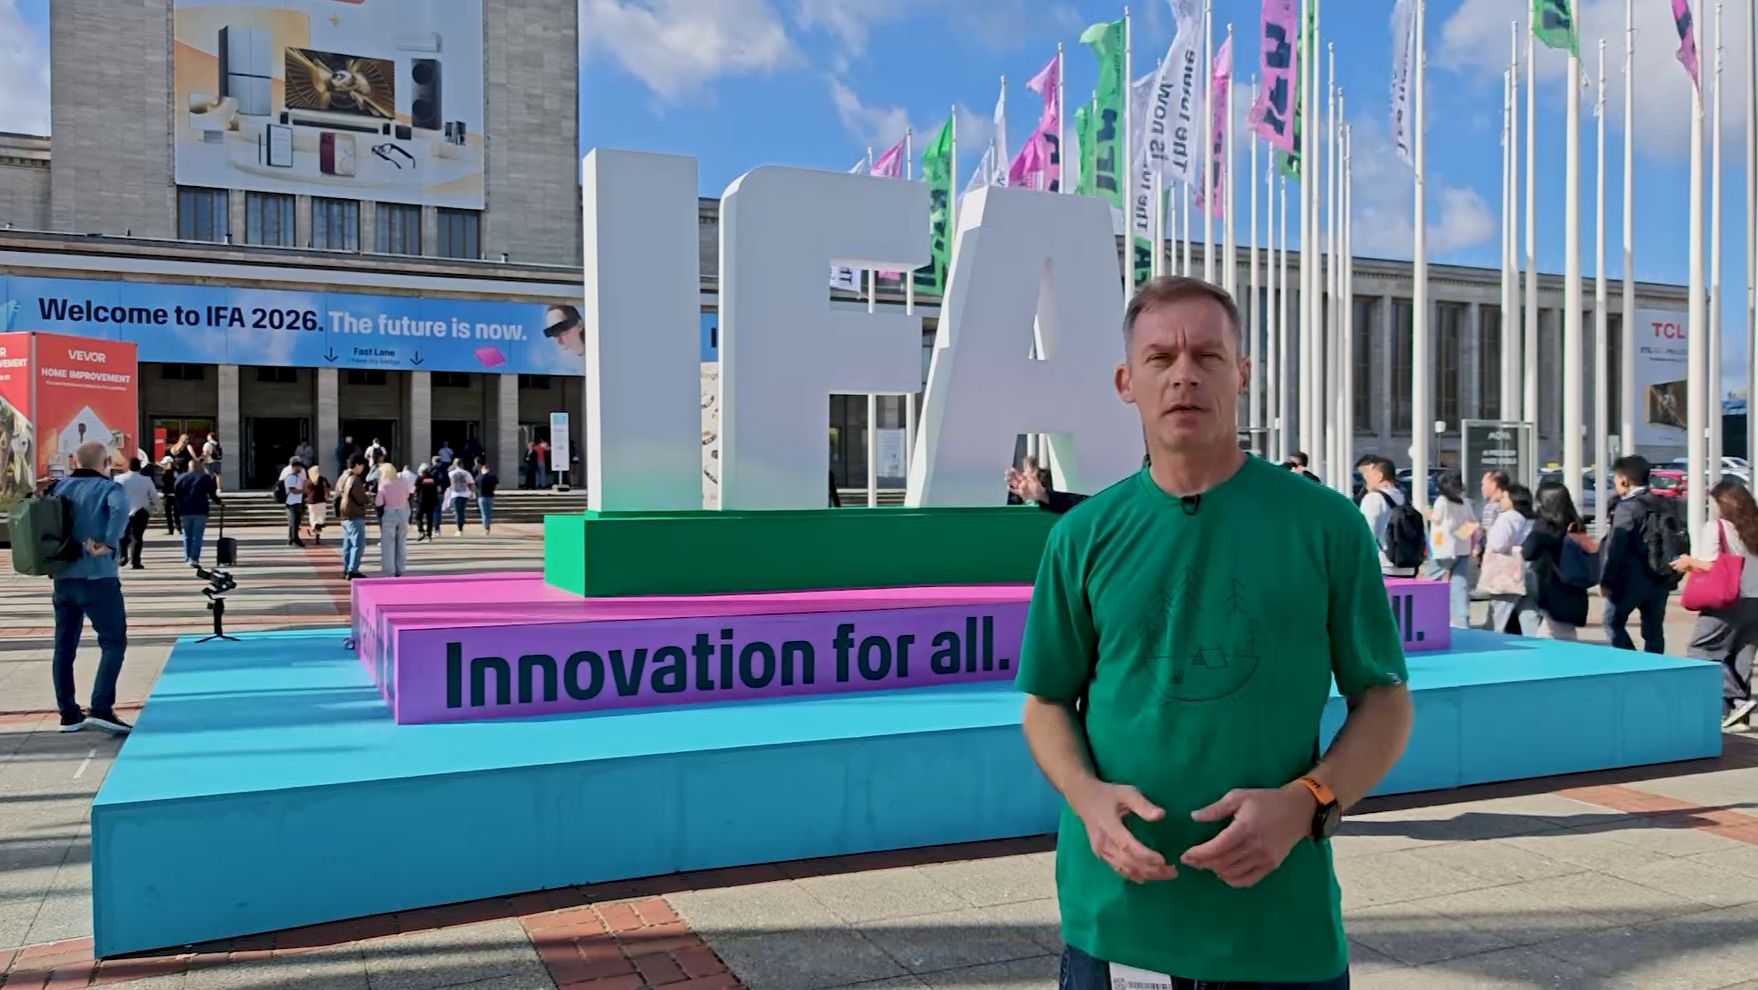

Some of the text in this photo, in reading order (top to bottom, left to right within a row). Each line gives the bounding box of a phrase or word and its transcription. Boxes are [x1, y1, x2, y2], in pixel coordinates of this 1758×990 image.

[38, 297, 528, 341] Welcome to IFA 2026. The future is now.
[583, 148, 1146, 513] IFA
[1651, 321, 1687, 339] TCL
[68, 349, 107, 363] VEVOR
[353, 346, 396, 357] Fast Lane
[41, 367, 131, 384] HOME IMPROVEMENT
[445, 615, 1010, 709] Innovation for all.
